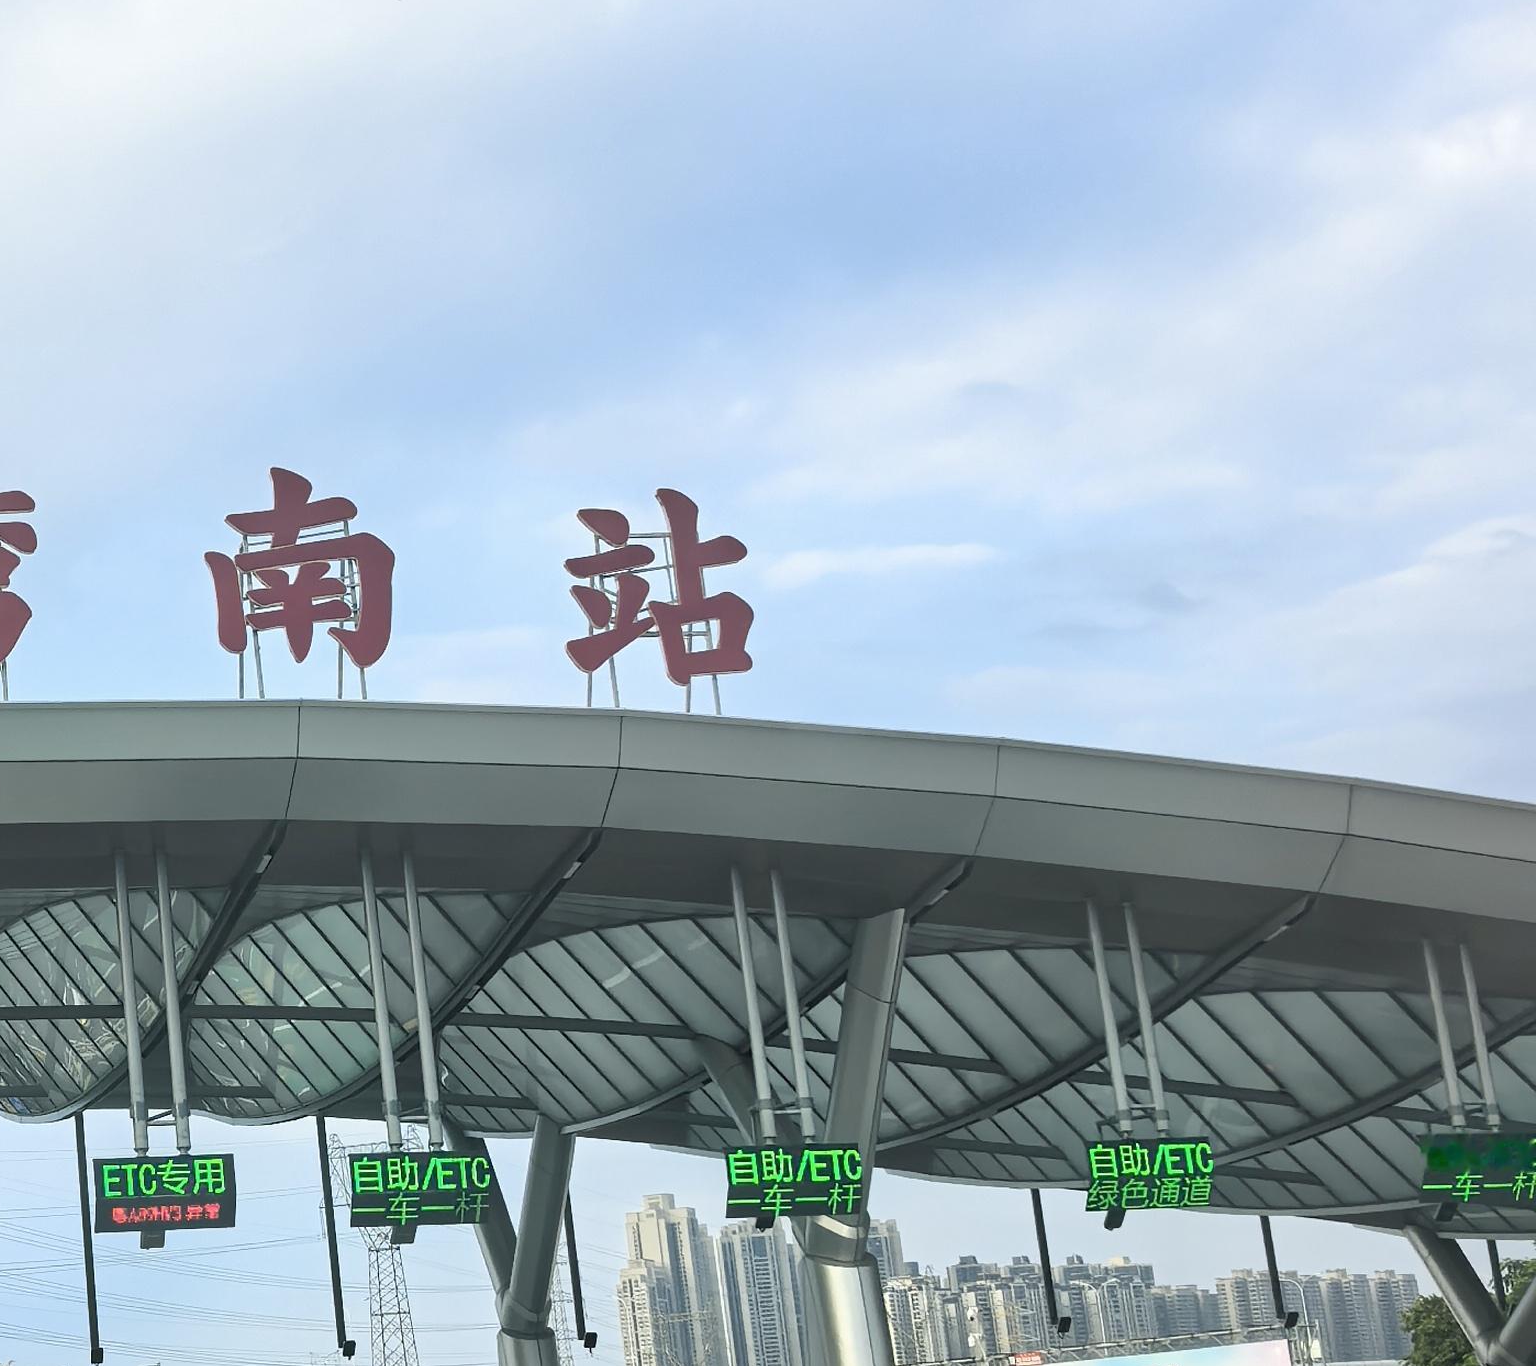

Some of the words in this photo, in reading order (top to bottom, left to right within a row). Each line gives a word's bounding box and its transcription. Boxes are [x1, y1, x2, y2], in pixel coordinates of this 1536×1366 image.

[102, 1158, 226, 1197] ETC专用
[353, 1157, 491, 1194] 自助/ETC
[728, 1148, 862, 1185] 自助/ETC
[1089, 1142, 1214, 1178] 自助/ETC
[352, 1192, 490, 1225] 一车一杆
[727, 1184, 862, 1217] 一车一杆
[1086, 1176, 1212, 1211] 绿色通道
